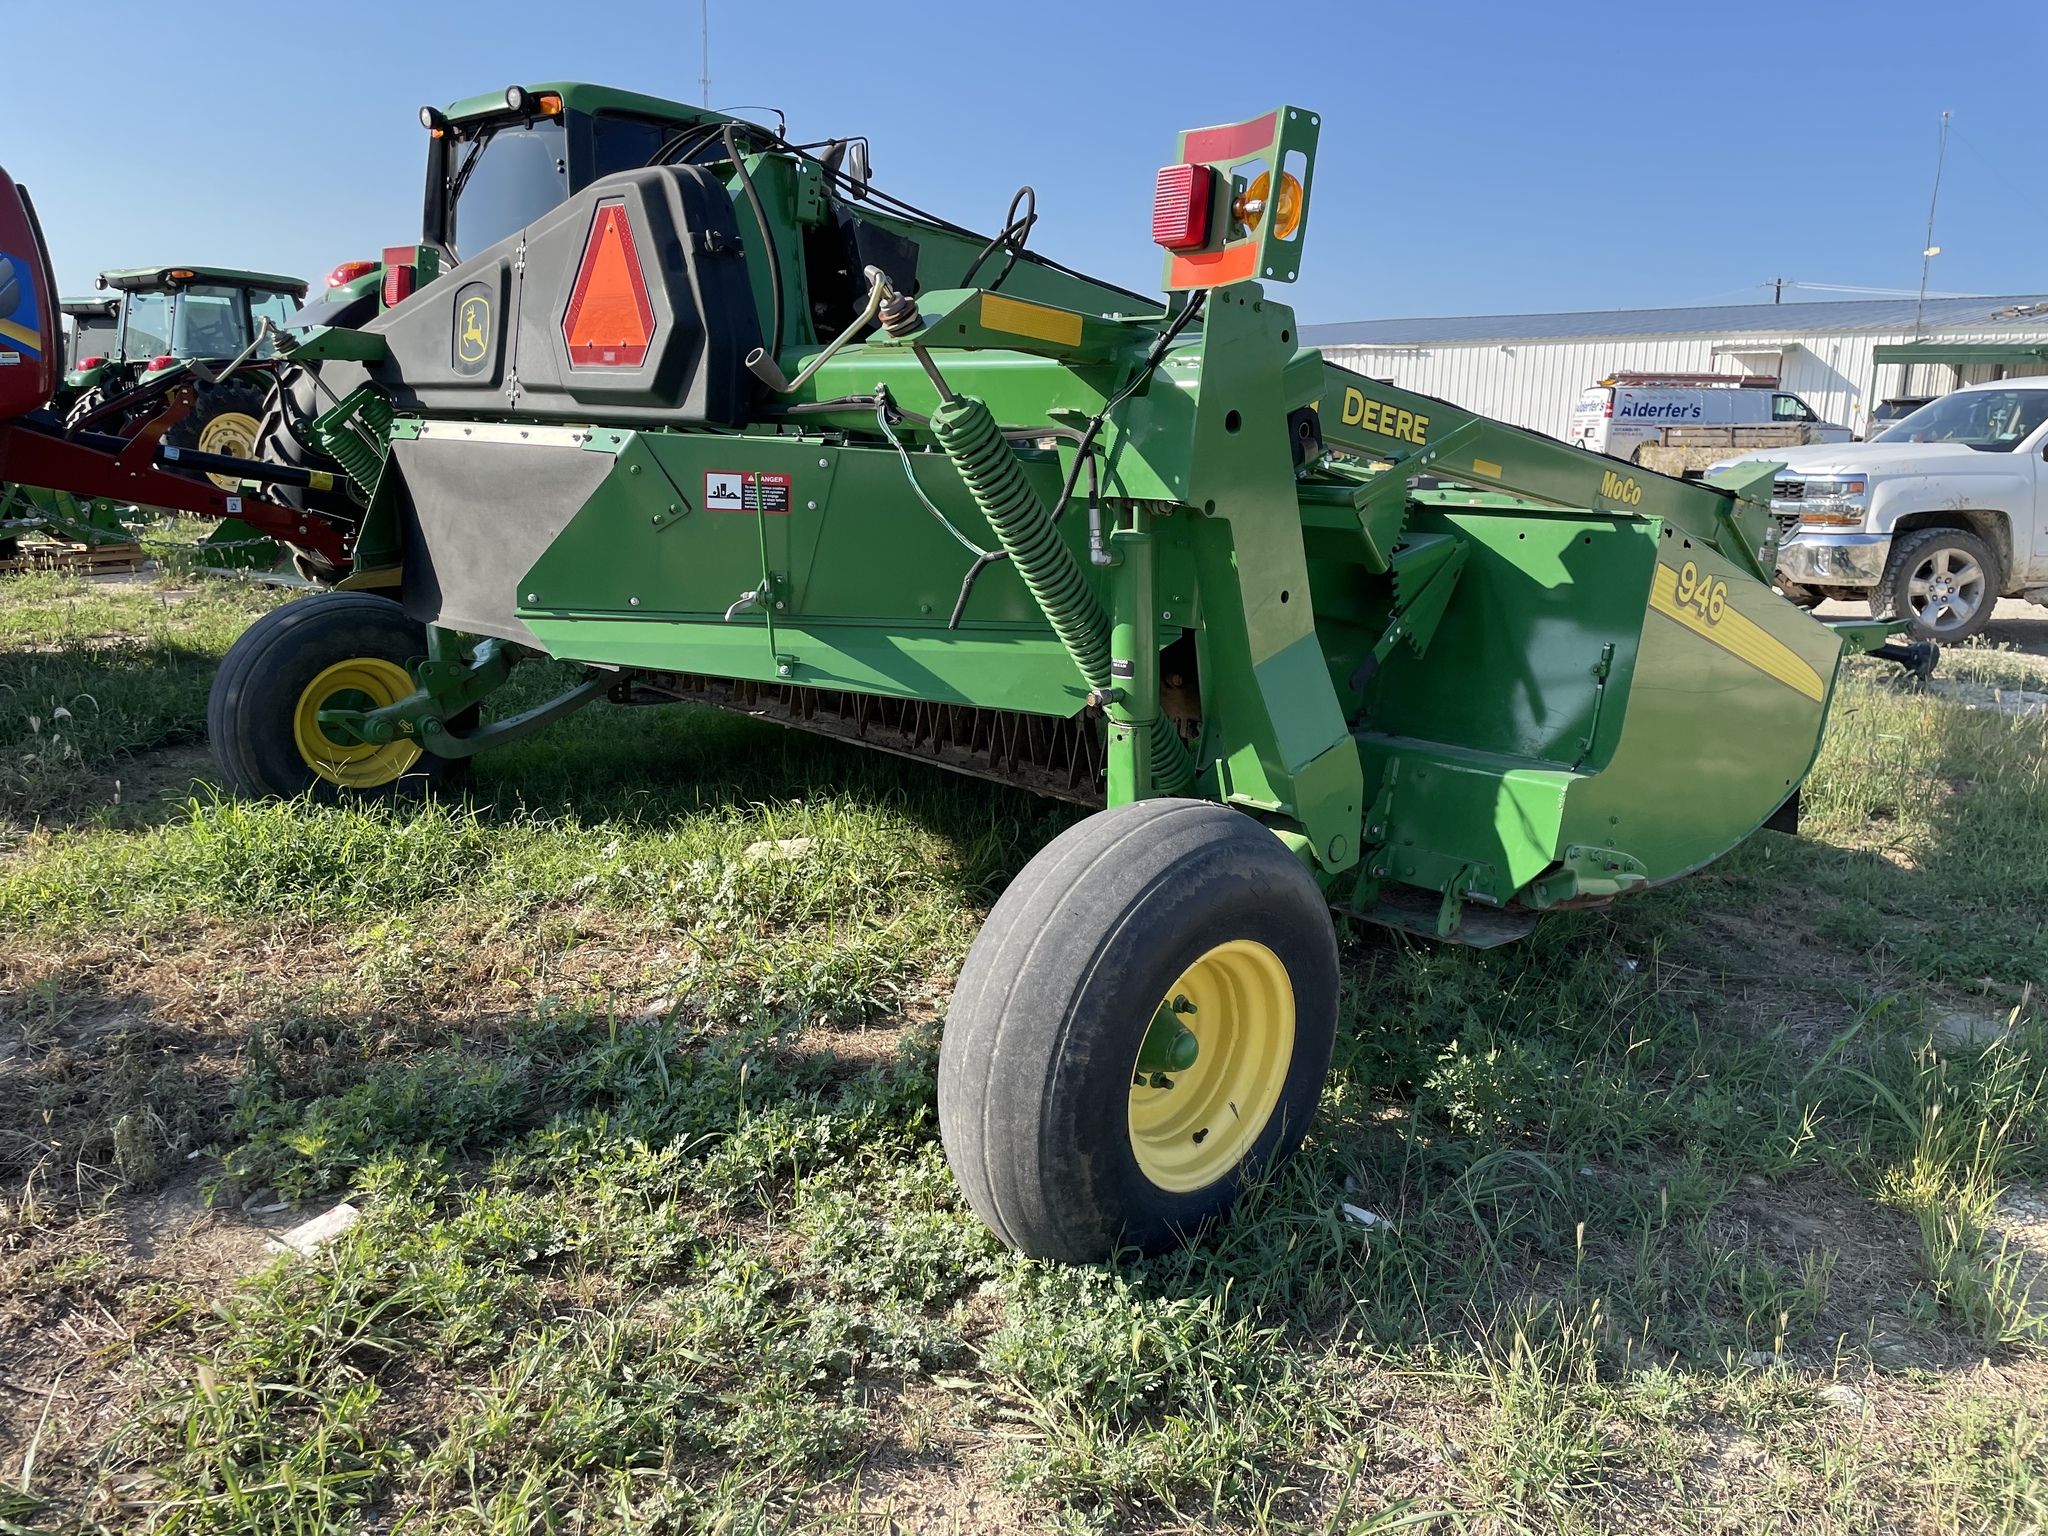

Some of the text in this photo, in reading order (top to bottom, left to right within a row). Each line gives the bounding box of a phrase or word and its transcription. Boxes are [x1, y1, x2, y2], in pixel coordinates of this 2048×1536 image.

[1341, 386, 1430, 446] DEERE
[1620, 402, 1702, 418] Alderfer's
[1601, 470, 1642, 505] MoCo
[1675, 560, 1728, 625] 946
